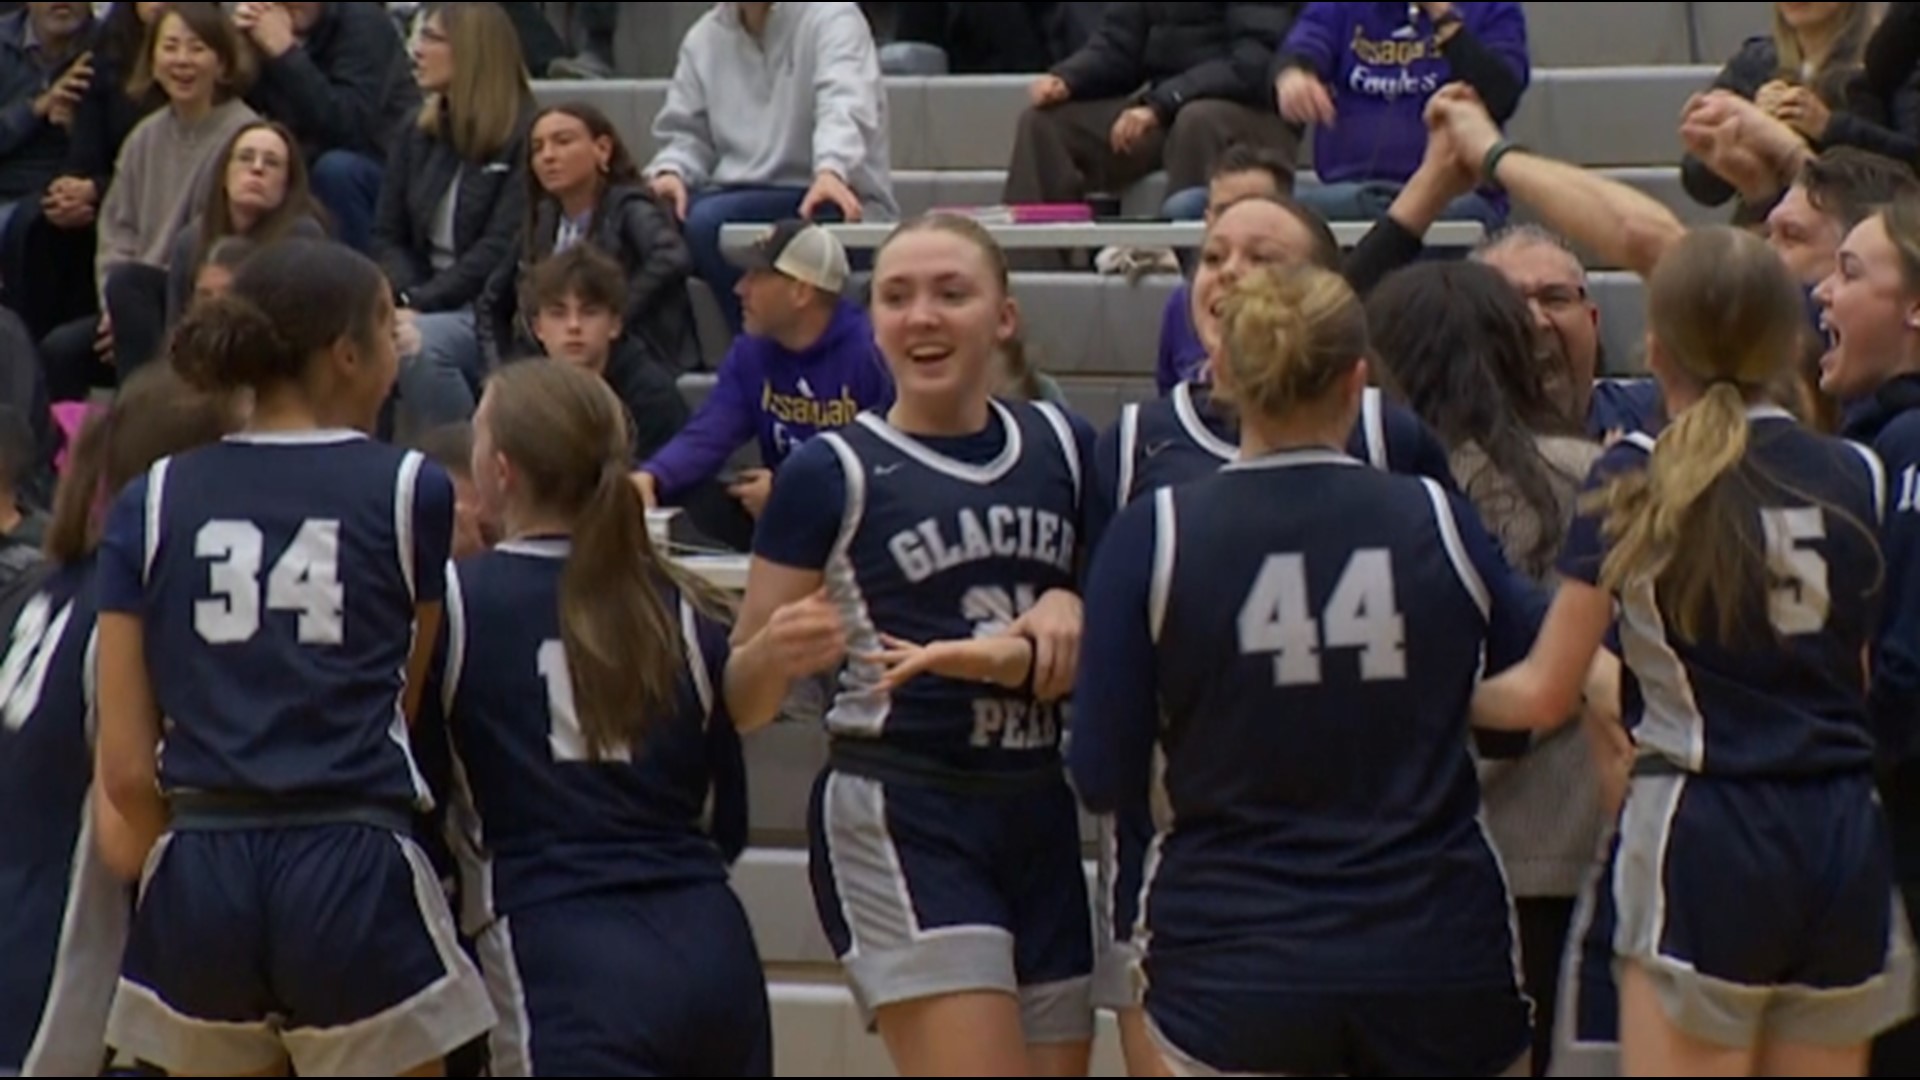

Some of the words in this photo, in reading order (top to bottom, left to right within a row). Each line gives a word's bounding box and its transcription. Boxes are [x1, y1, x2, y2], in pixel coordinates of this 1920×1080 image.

[194, 518, 344, 644] 34
[1236, 547, 1407, 686] 44
[1759, 506, 1831, 635] 5
